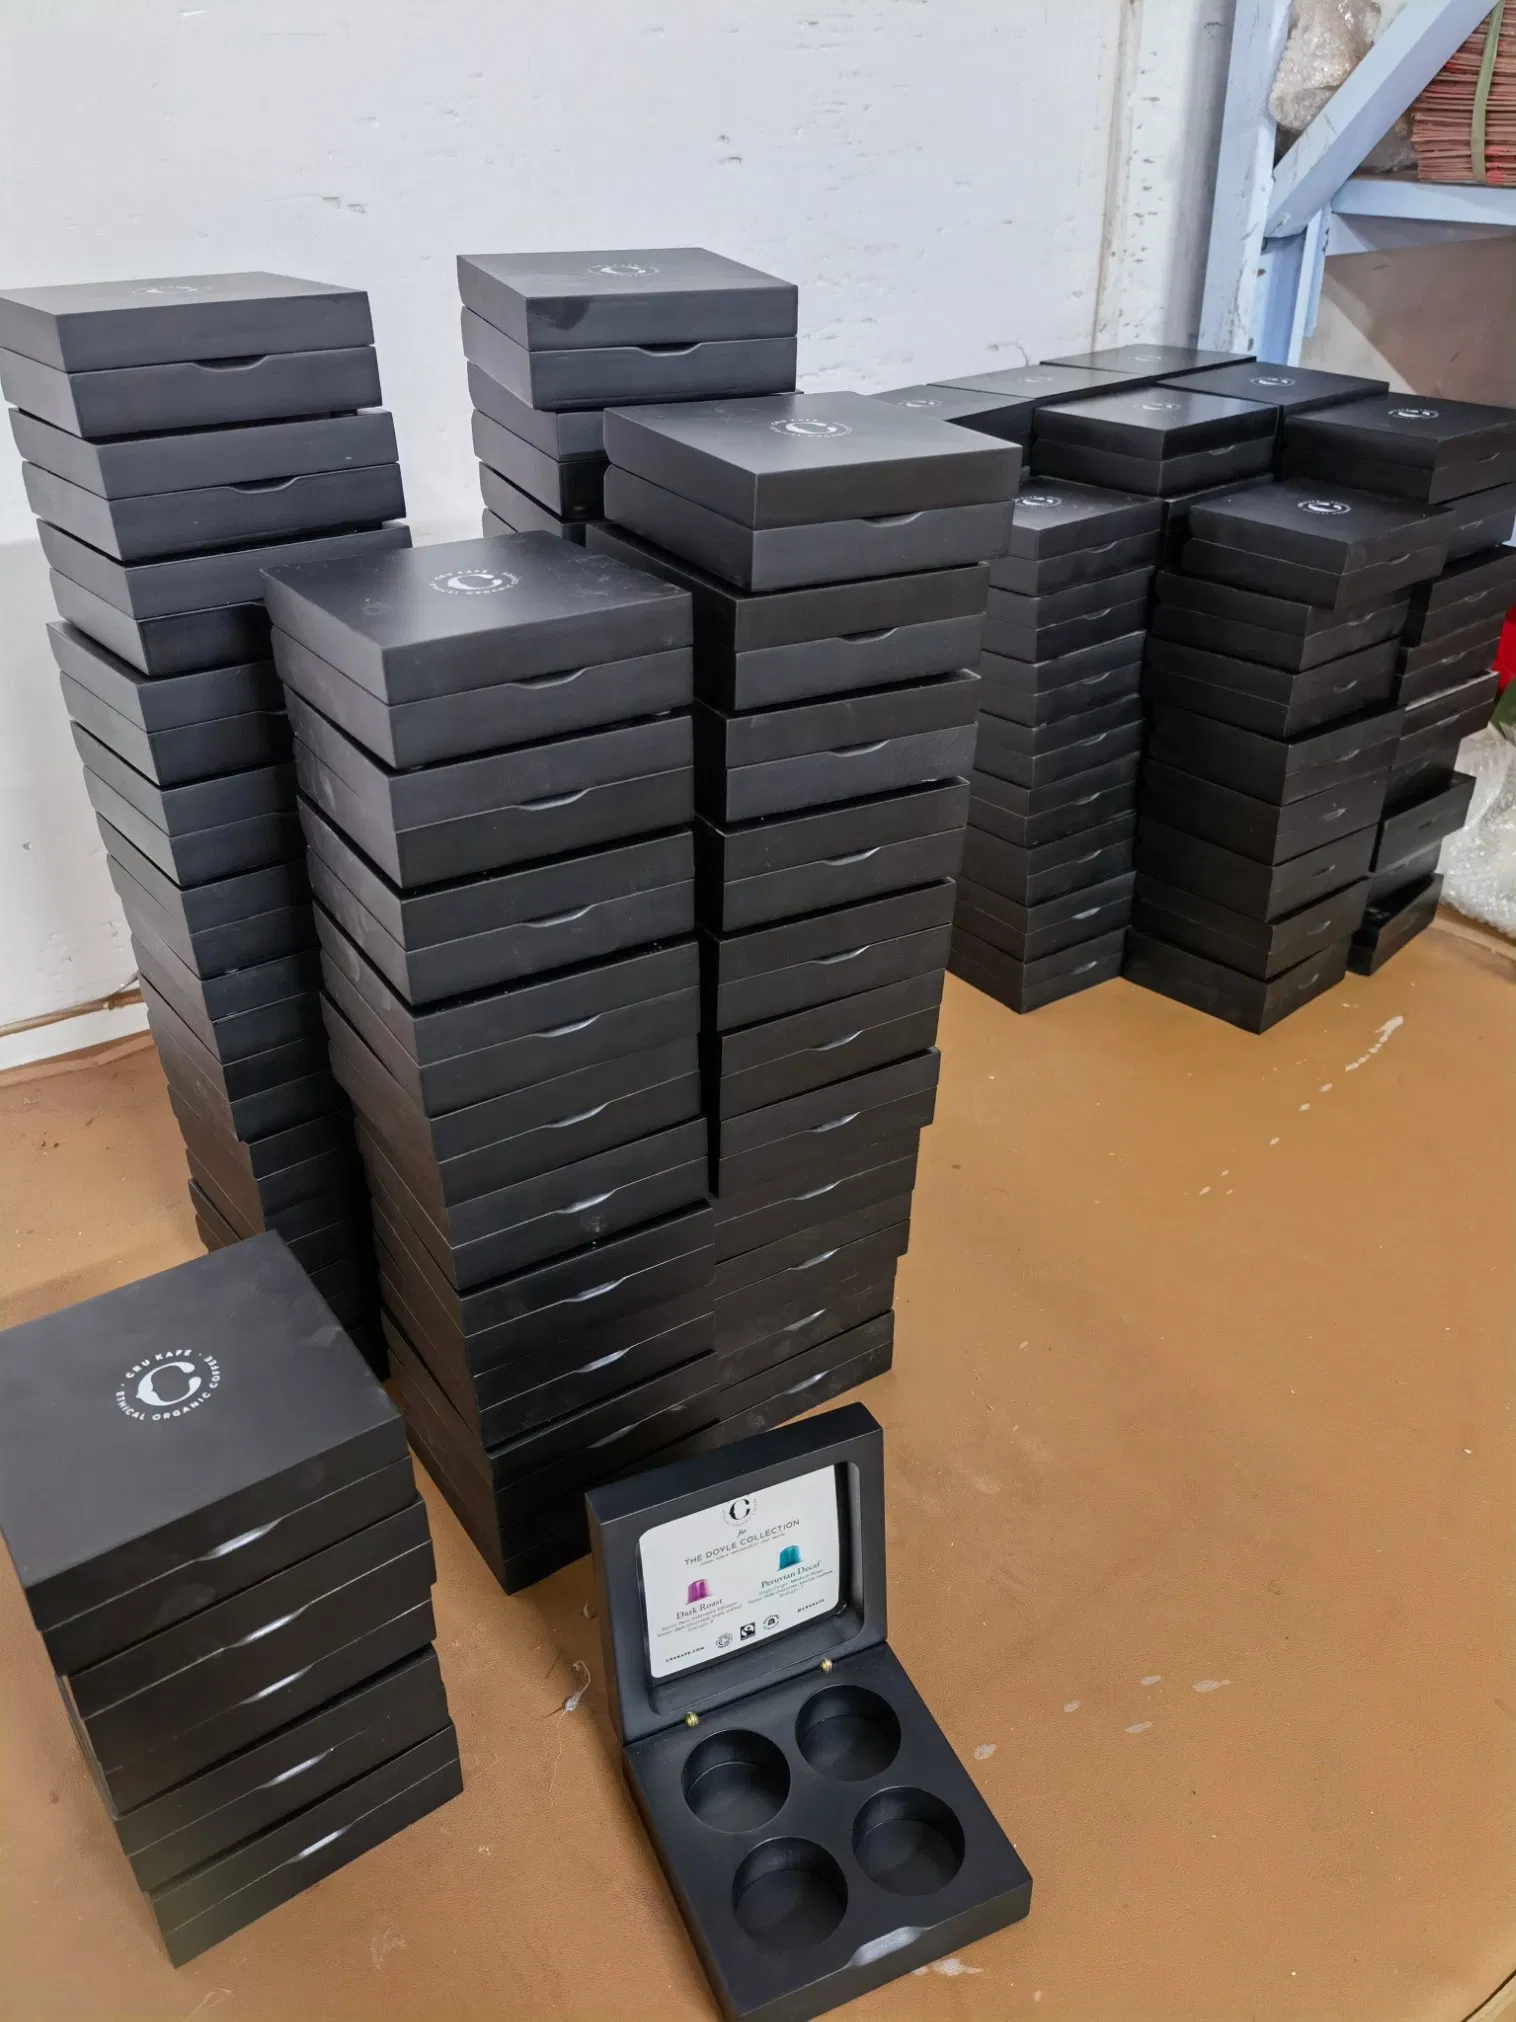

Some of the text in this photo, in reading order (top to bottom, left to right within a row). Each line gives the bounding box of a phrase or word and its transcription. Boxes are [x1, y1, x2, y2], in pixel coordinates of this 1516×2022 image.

[151, 1391, 211, 1421] ORGANIC
[684, 1554, 703, 1566] THE
[705, 1541, 738, 1559] DOYLE
[739, 1518, 801, 1546] COLLECTION
[760, 1569, 797, 1589] Peruvian
[797, 1560, 822, 1576] Decaf
[676, 1607, 698, 1620] Dark
[698, 1598, 723, 1611] Roast
